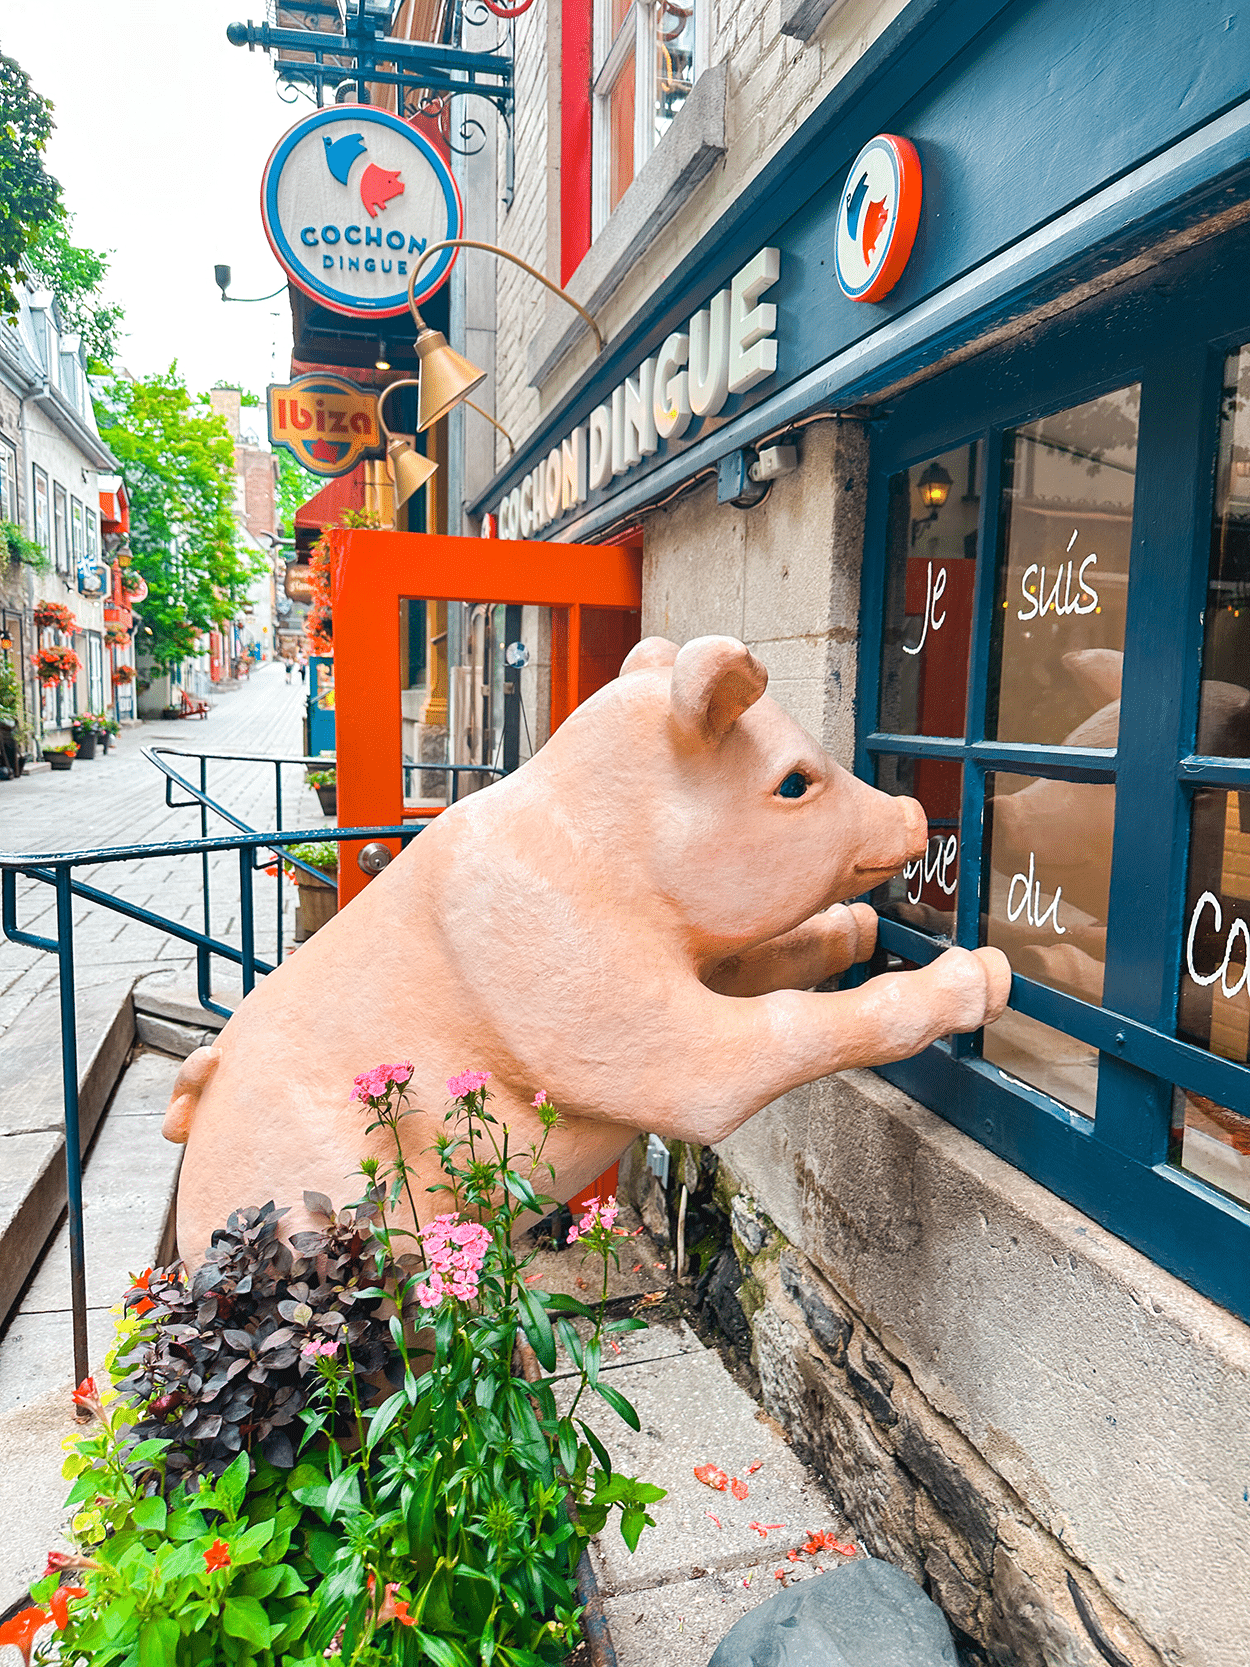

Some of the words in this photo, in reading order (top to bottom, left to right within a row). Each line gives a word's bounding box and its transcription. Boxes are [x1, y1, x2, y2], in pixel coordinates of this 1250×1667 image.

[300, 224, 427, 256] COCHON
[322, 254, 408, 276] DINGUE
[498, 426, 587, 540] COCHON
[589, 246, 781, 492] DINGUE
[277, 398, 372, 434] Ibiza
[1007, 851, 1066, 935] du
